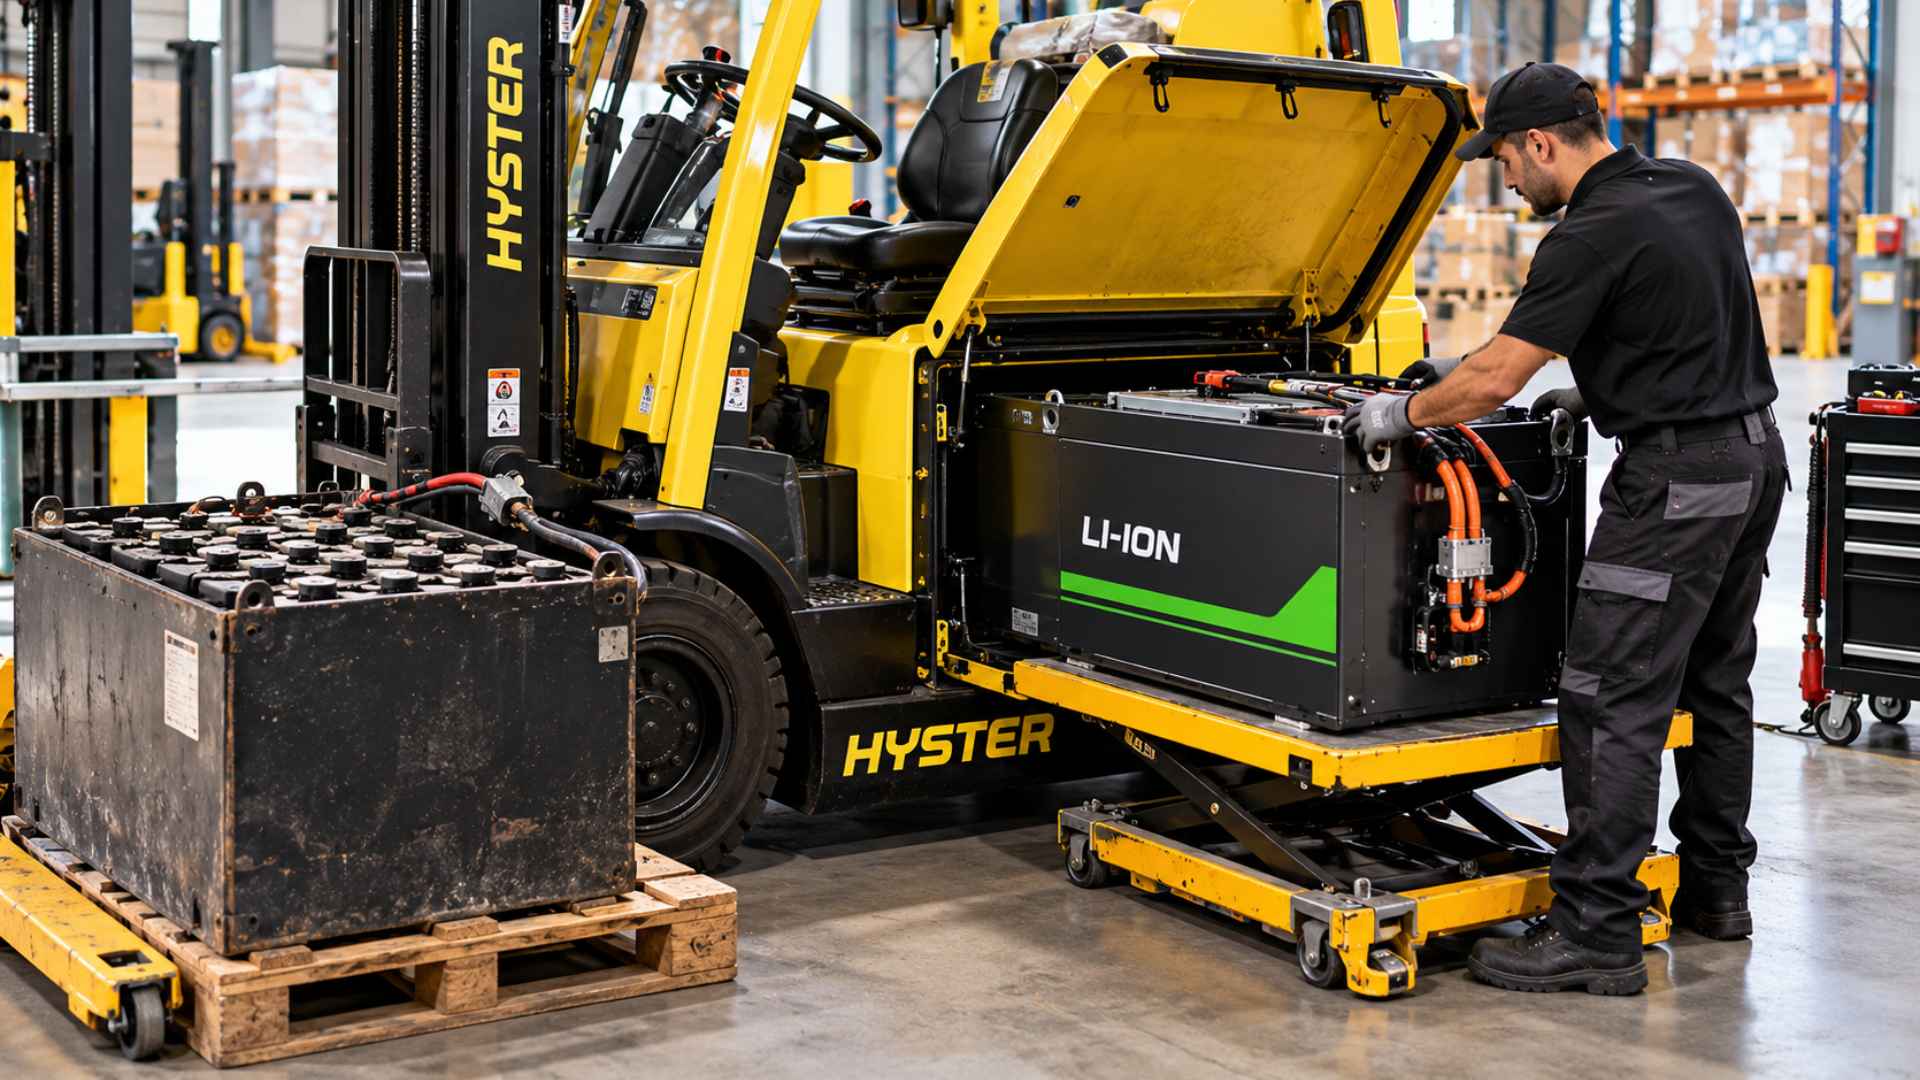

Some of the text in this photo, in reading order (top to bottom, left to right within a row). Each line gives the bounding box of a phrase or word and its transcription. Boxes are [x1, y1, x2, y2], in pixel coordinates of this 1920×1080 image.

[487, 36, 524, 272] HYSTER
[1081, 515, 1182, 564] LI-ION
[842, 713, 1054, 778] HYSTER
